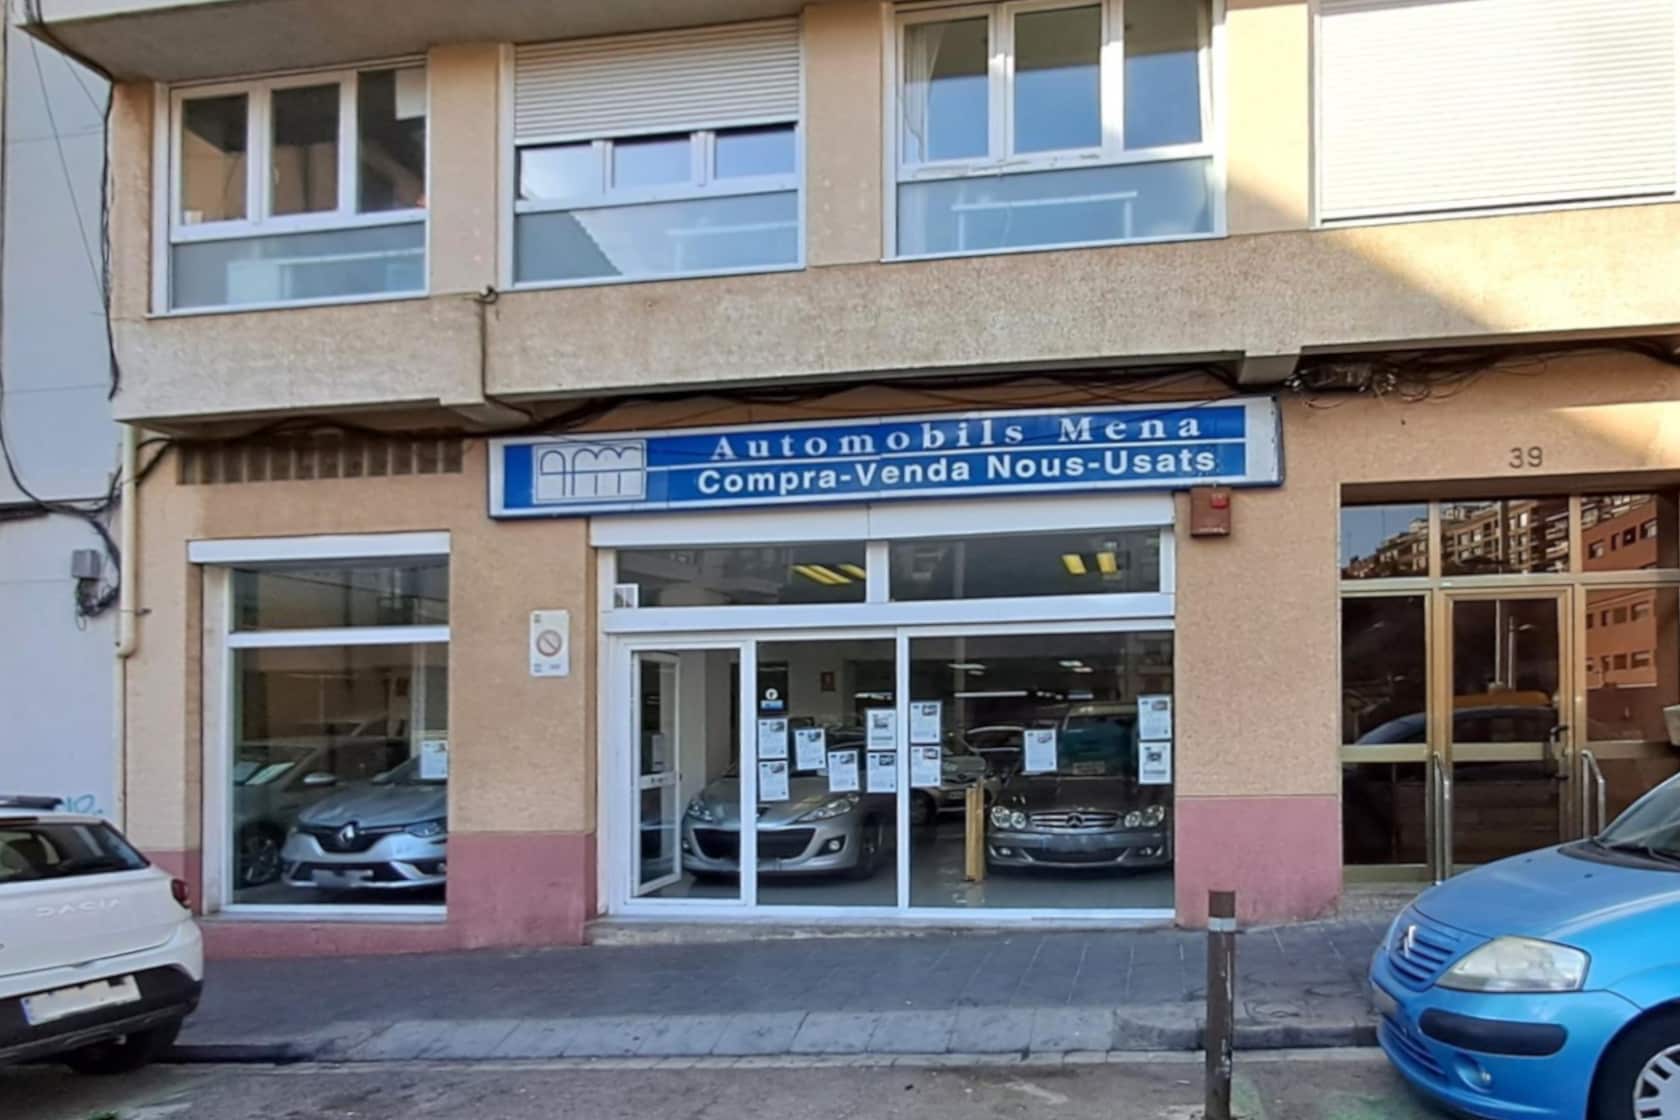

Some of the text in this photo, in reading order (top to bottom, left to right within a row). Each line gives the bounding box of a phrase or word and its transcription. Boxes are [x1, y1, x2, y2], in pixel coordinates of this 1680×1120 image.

[710, 416, 1201, 460] Automobils Mena
[699, 448, 1216, 496] Compra-Venda Nous-Usats
[1509, 446, 1542, 469] 39
[35, 898, 120, 918] DACIA
